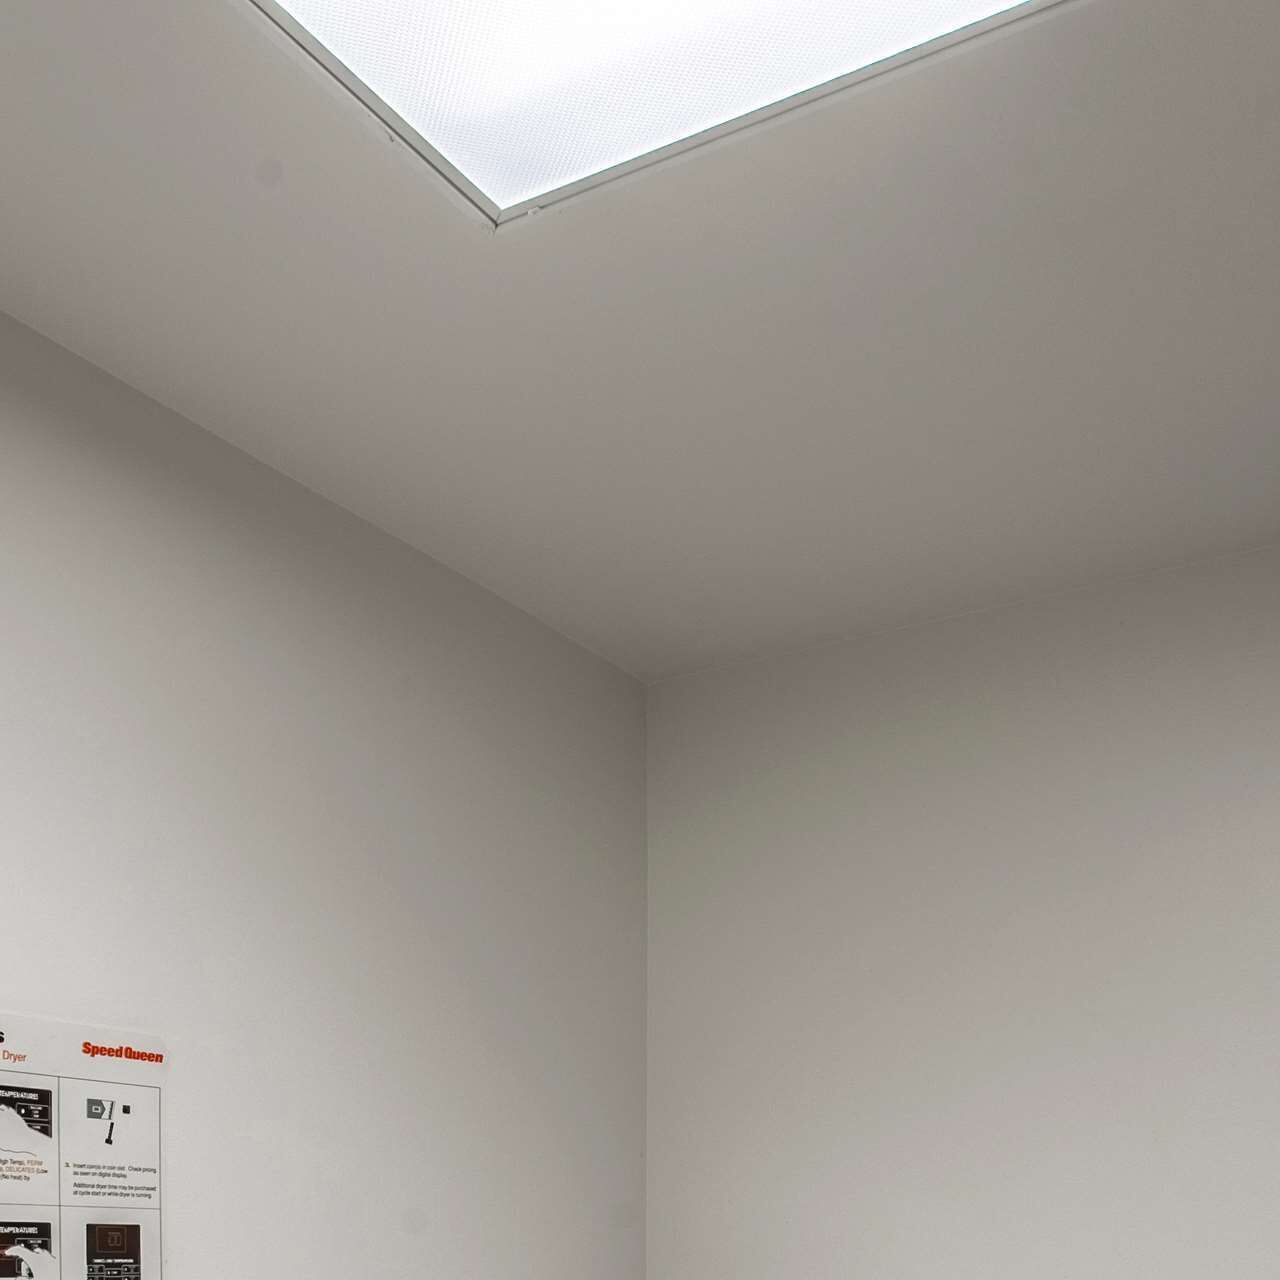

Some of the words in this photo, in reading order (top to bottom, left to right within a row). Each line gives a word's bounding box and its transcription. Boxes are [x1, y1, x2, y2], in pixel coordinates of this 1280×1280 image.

[3, 1051, 27, 1063] Dryer
[82, 1041, 123, 1057] Speed
[125, 1046, 164, 1063] Queen
